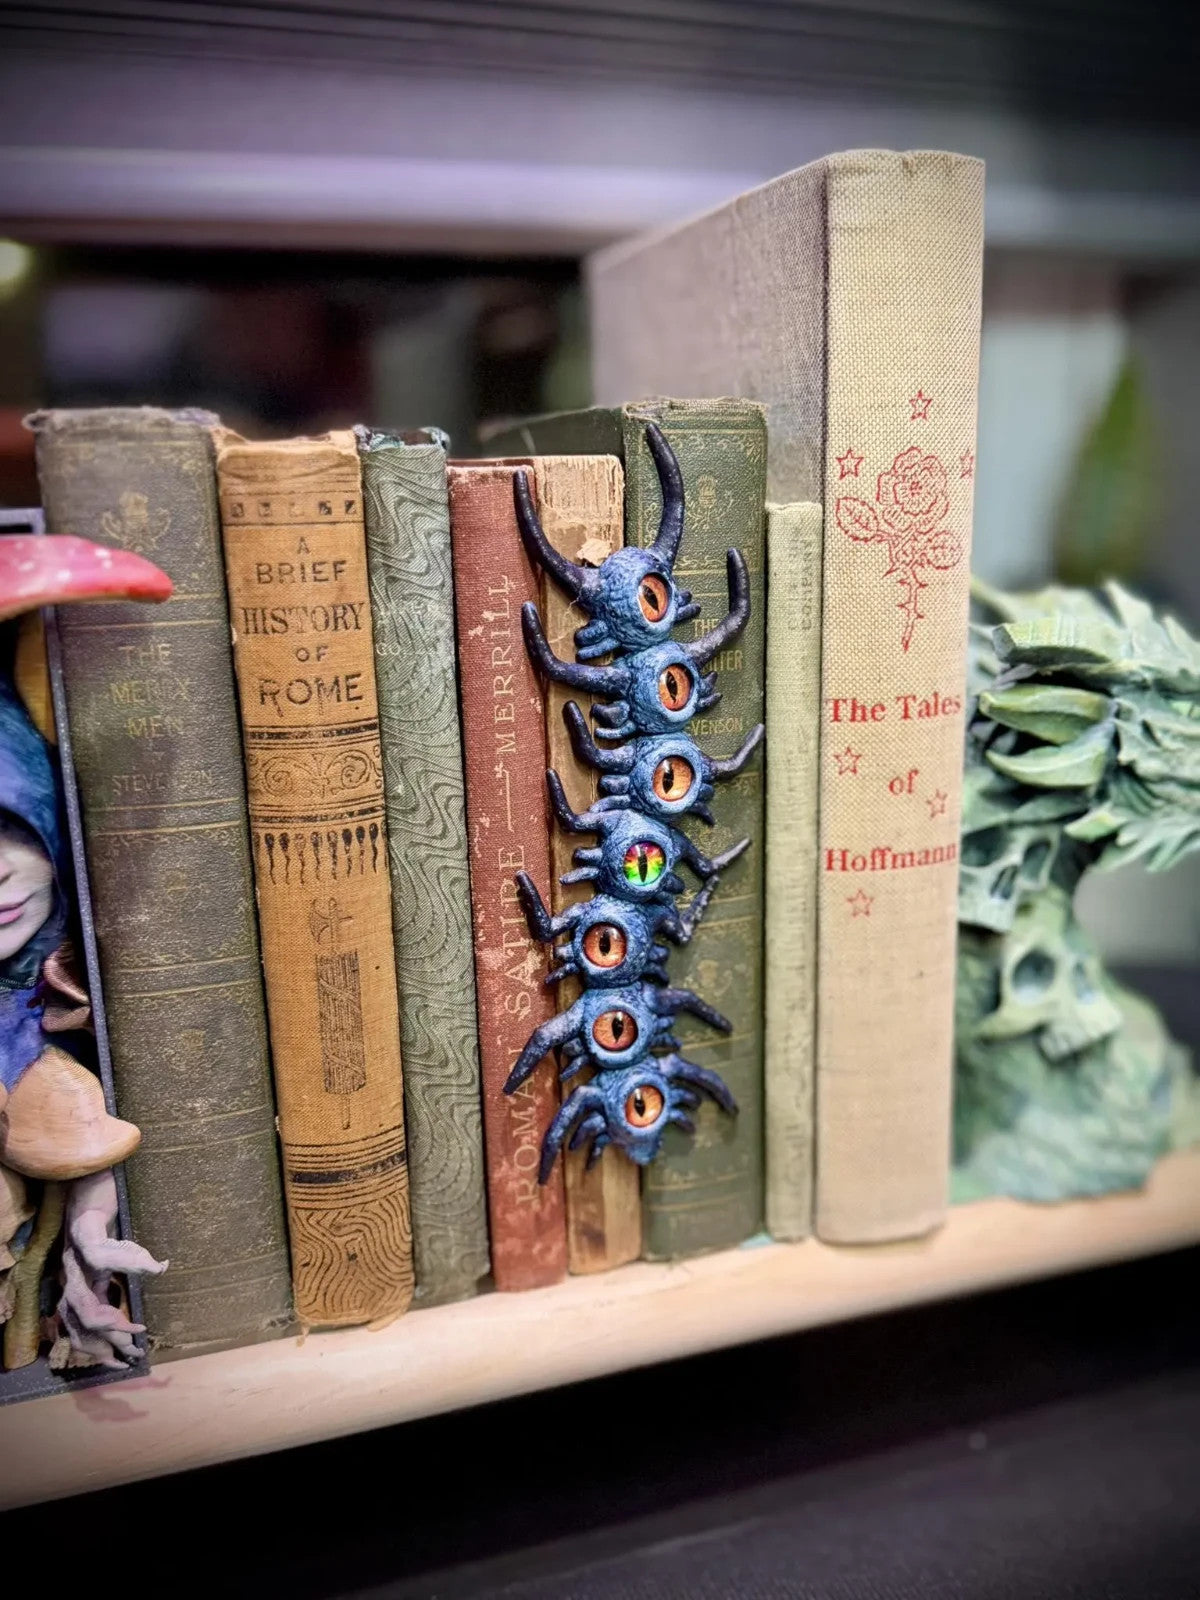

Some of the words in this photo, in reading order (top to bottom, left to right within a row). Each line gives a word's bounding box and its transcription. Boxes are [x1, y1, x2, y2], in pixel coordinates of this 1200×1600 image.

[298, 537, 310, 554] A
[256, 560, 347, 584] BRIEF
[240, 603, 365, 635] HISTORY
[118, 643, 172, 666] THE
[296, 646, 329, 662] OF
[486, 575, 517, 755] MERRILL
[260, 674, 364, 717] ROME
[826, 697, 886, 723] The
[897, 691, 962, 721] Tales
[126, 714, 185, 740] MEN
[888, 768, 919, 796] of
[825, 843, 957, 872] Hoffmann
[499, 845, 537, 1021] SATIRE
